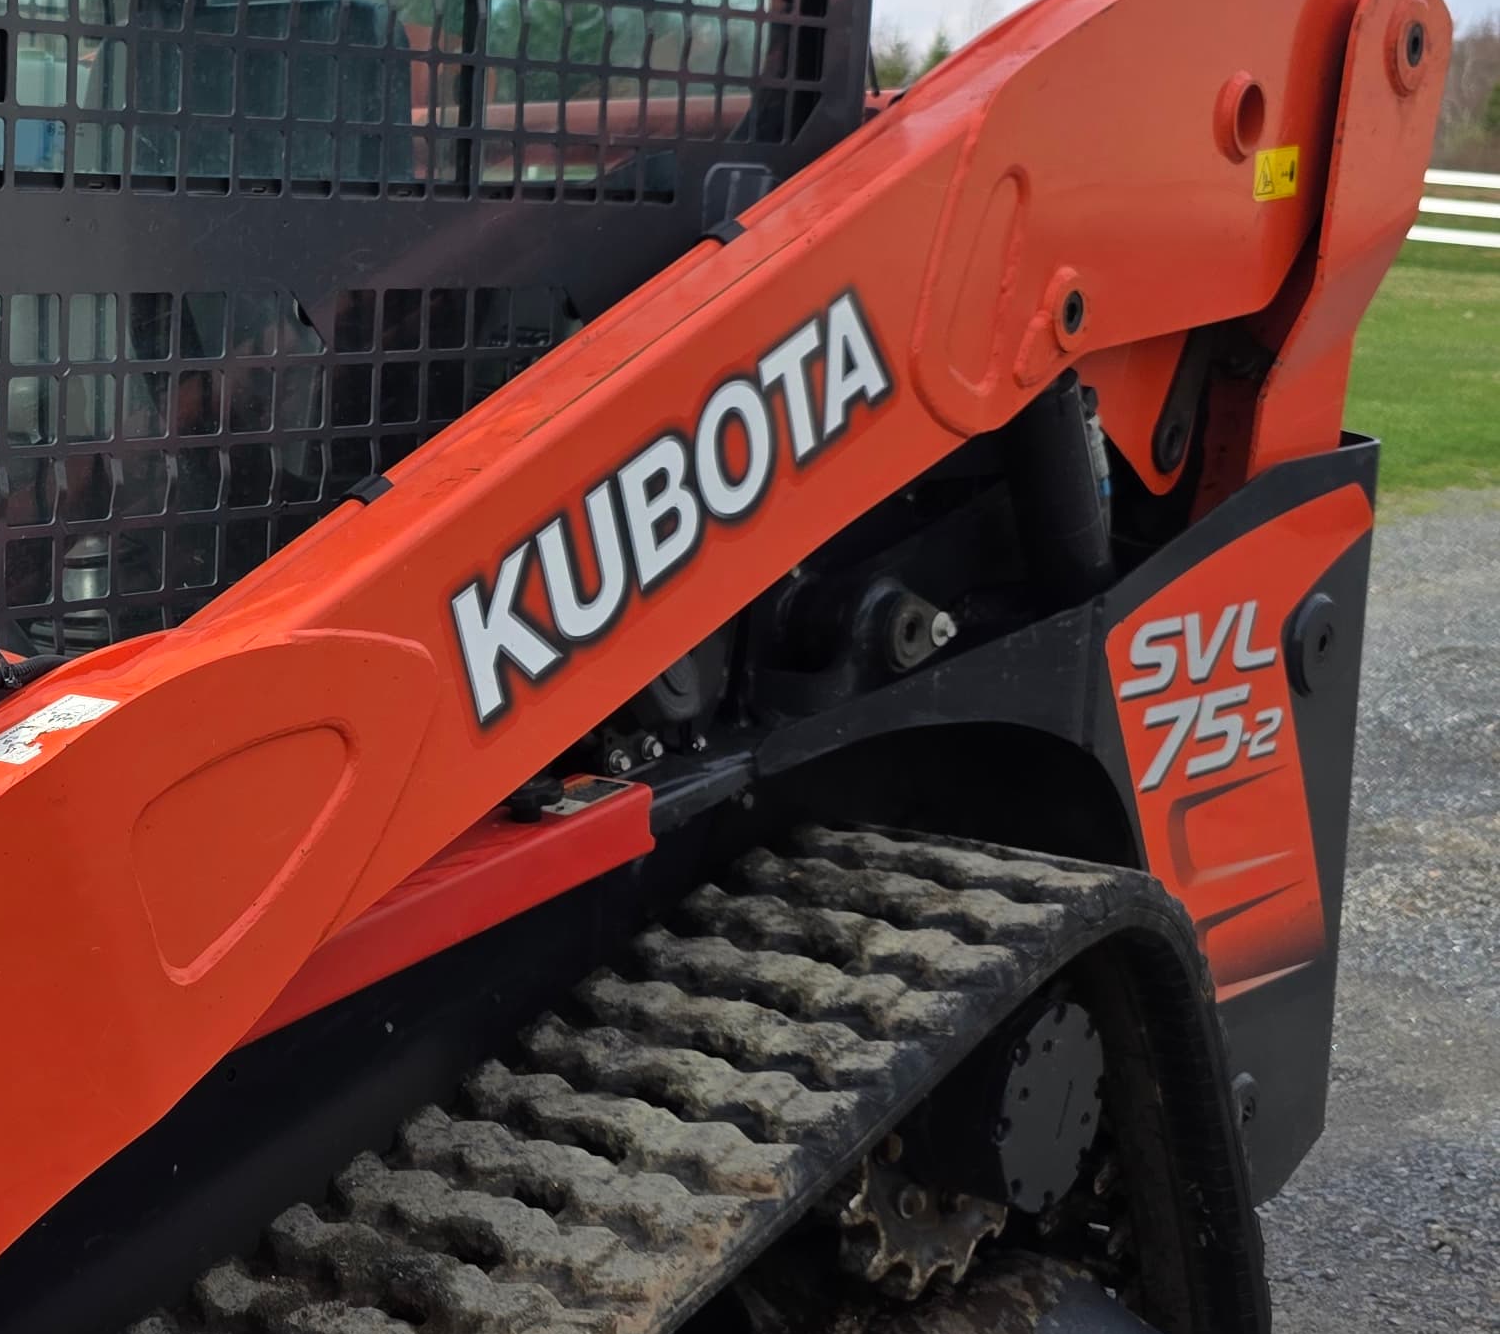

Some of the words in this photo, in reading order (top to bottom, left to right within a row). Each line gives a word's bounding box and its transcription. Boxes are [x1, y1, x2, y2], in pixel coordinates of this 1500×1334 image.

[449, 290, 891, 727] KUBOTA
[1118, 599, 1277, 701] SVL
[1138, 682, 1284, 793] 75-2
